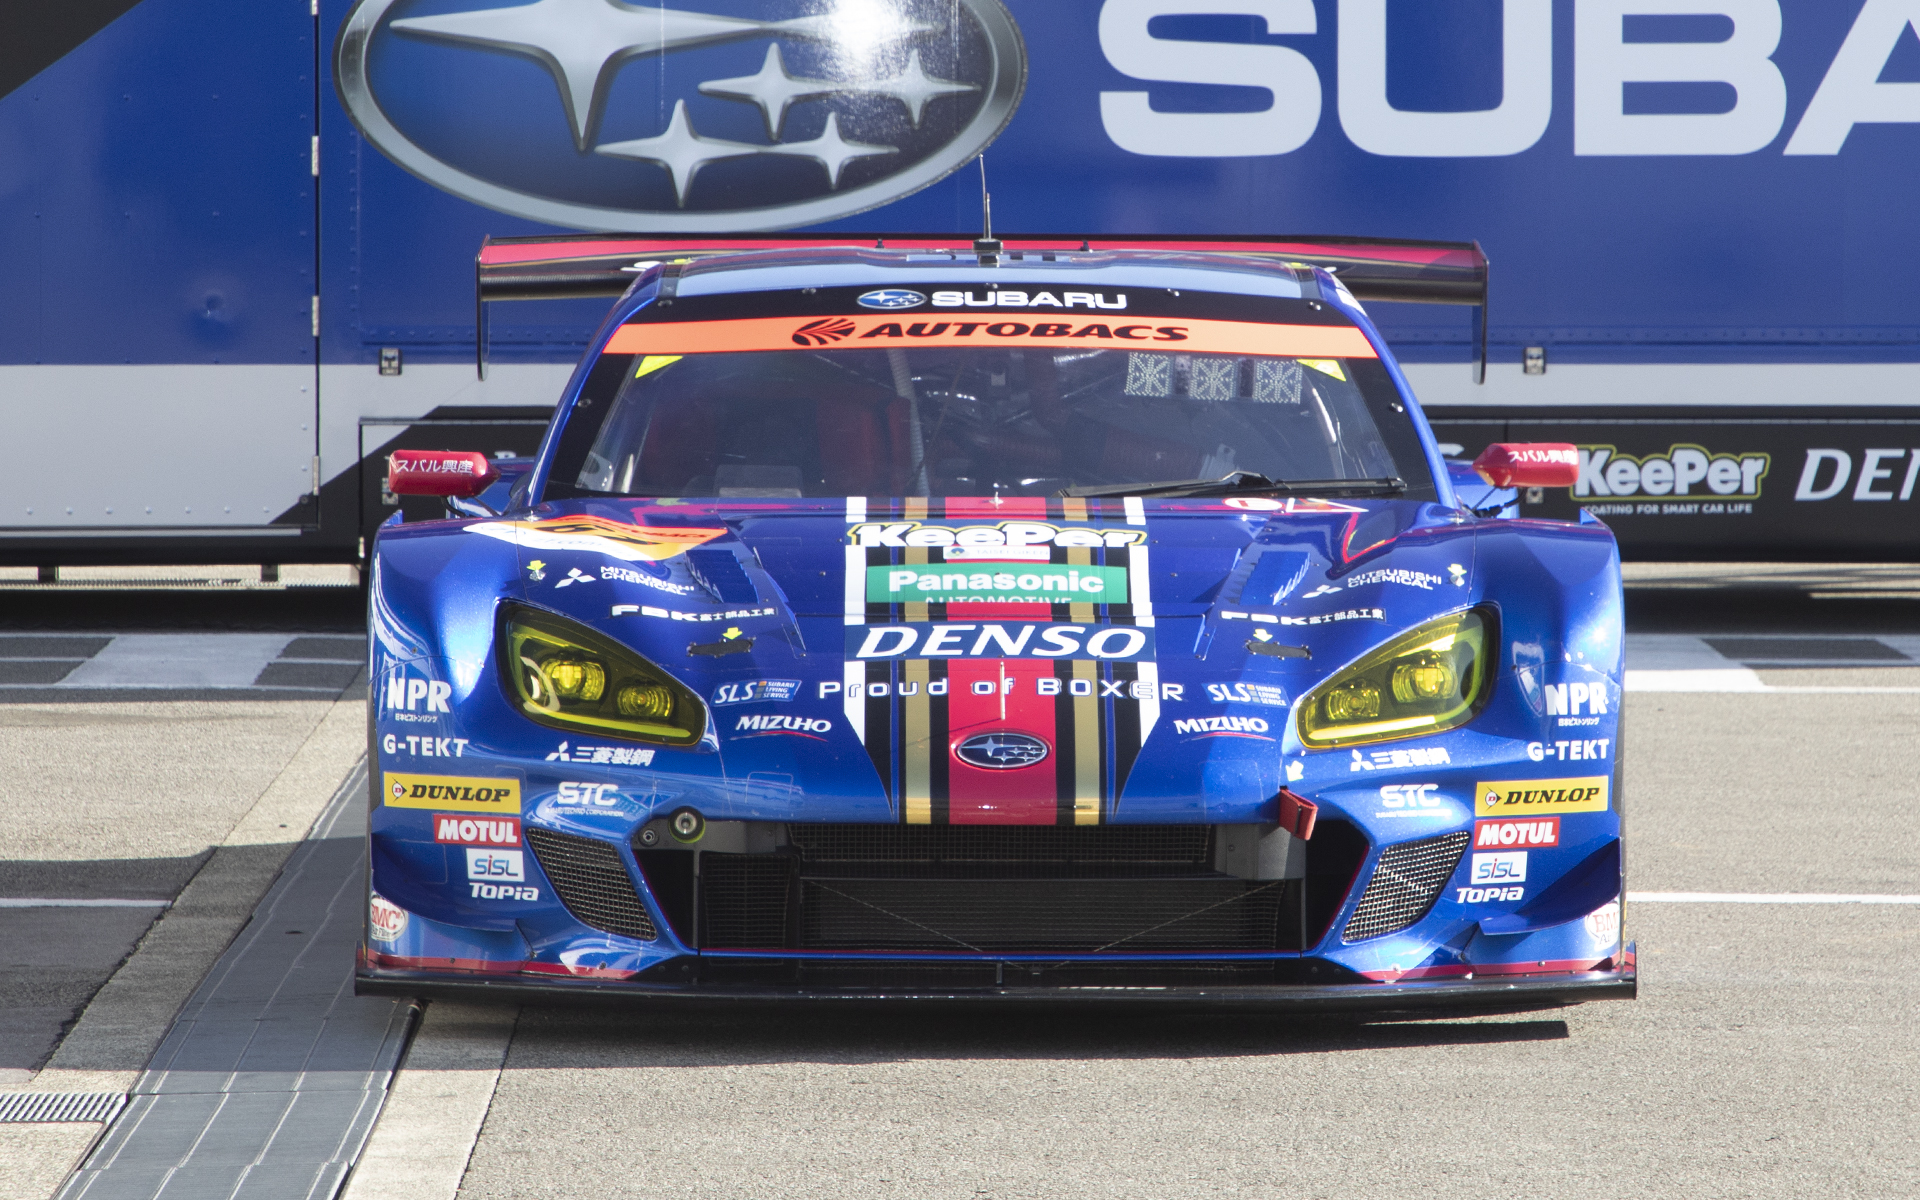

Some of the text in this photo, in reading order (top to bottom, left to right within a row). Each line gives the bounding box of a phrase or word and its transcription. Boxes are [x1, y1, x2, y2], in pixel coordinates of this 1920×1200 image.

[932, 291, 1127, 309] SUBARU
[858, 322, 1189, 342] AUTOBACS
[397, 459, 474, 474] スバル興産
[1574, 448, 1765, 497] KeePer
[1637, 503, 1660, 514] FOR
[1662, 503, 1699, 514] SMART
[1702, 503, 1724, 514] CAR
[1727, 503, 1752, 514] LIFE
[854, 522, 1143, 548] KeePer
[600, 566, 694, 591] MITSUBISHI
[601, 573, 687, 596] CHEMICAL
[889, 571, 1104, 593] Panasonic
[1348, 569, 1442, 584] MITSUBISHI
[1348, 575, 1433, 590] CHEMICAL
[855, 624, 1146, 658] DENSO
[387, 677, 452, 713] NPR
[715, 682, 757, 704] SLS
[971, 677, 1016, 696] of
[1036, 678, 1184, 701] BOXER
[1207, 683, 1251, 702] SLS
[1544, 682, 1608, 715] NPR
[735, 715, 832, 733] MIZUHO
[1173, 716, 1269, 734] MIZUHO
[383, 733, 469, 757] G-TEKT
[1527, 739, 1610, 762] G-TEKT
[409, 784, 511, 802] DUNLOP
[556, 782, 619, 806] STC
[1380, 783, 1441, 808] STC
[1504, 787, 1600, 805] DUNLOP
[437, 818, 518, 844] MOTUL
[1477, 822, 1556, 846] MOTUL
[1592, 911, 1619, 933] BM
